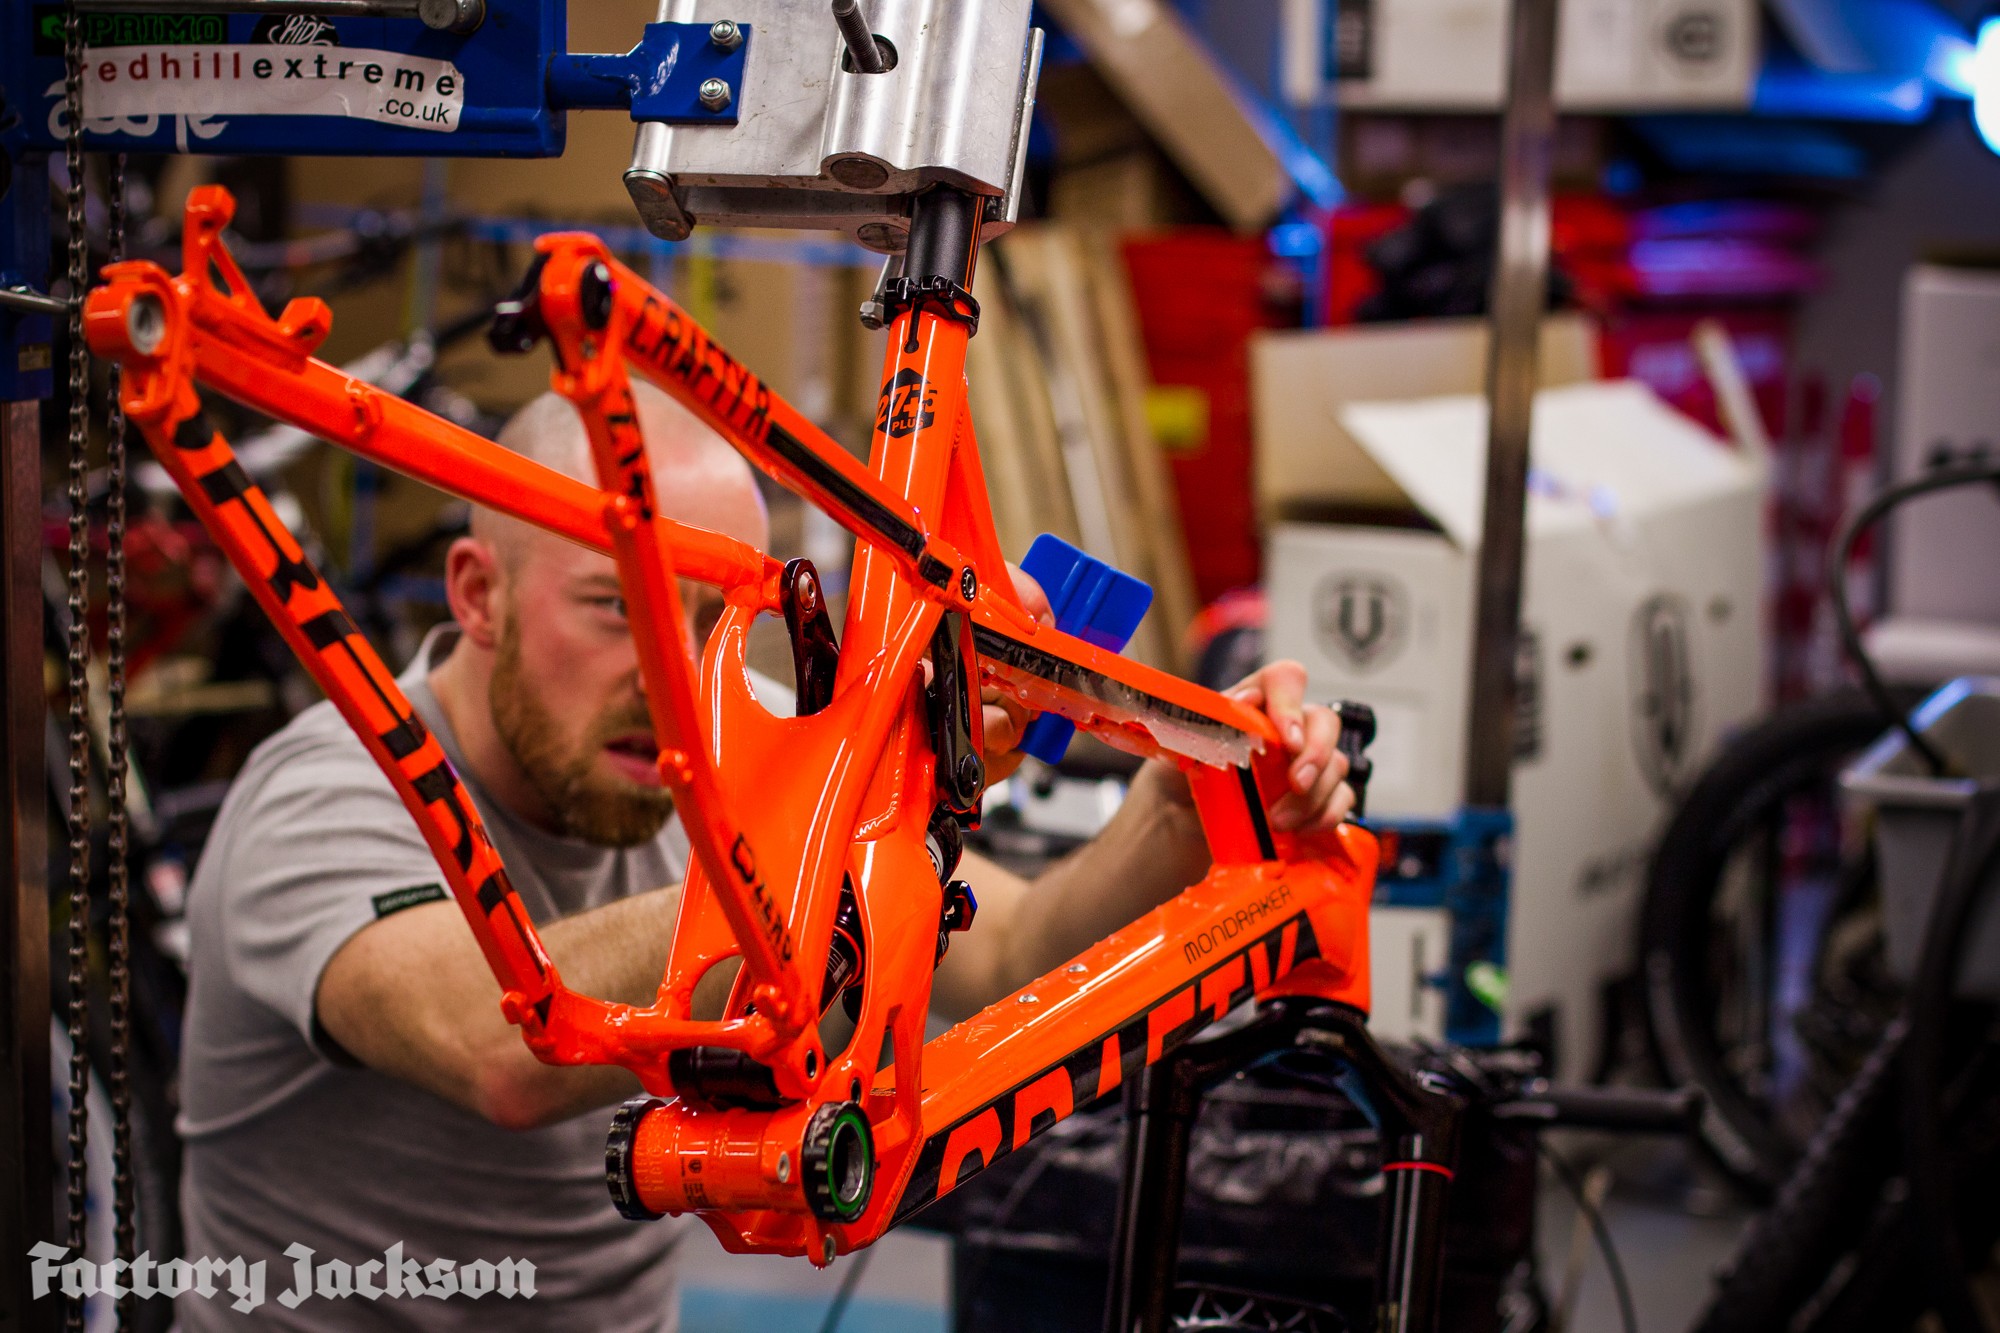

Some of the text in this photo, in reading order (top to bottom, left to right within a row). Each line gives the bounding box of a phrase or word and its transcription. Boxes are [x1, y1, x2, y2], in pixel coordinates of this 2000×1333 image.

[87, 14, 222, 44] PRIMO
[378, 98, 450, 124] .co.uk
[891, 417, 925, 432] PLUS
[1184, 885, 1293, 964] MONDRAKER
